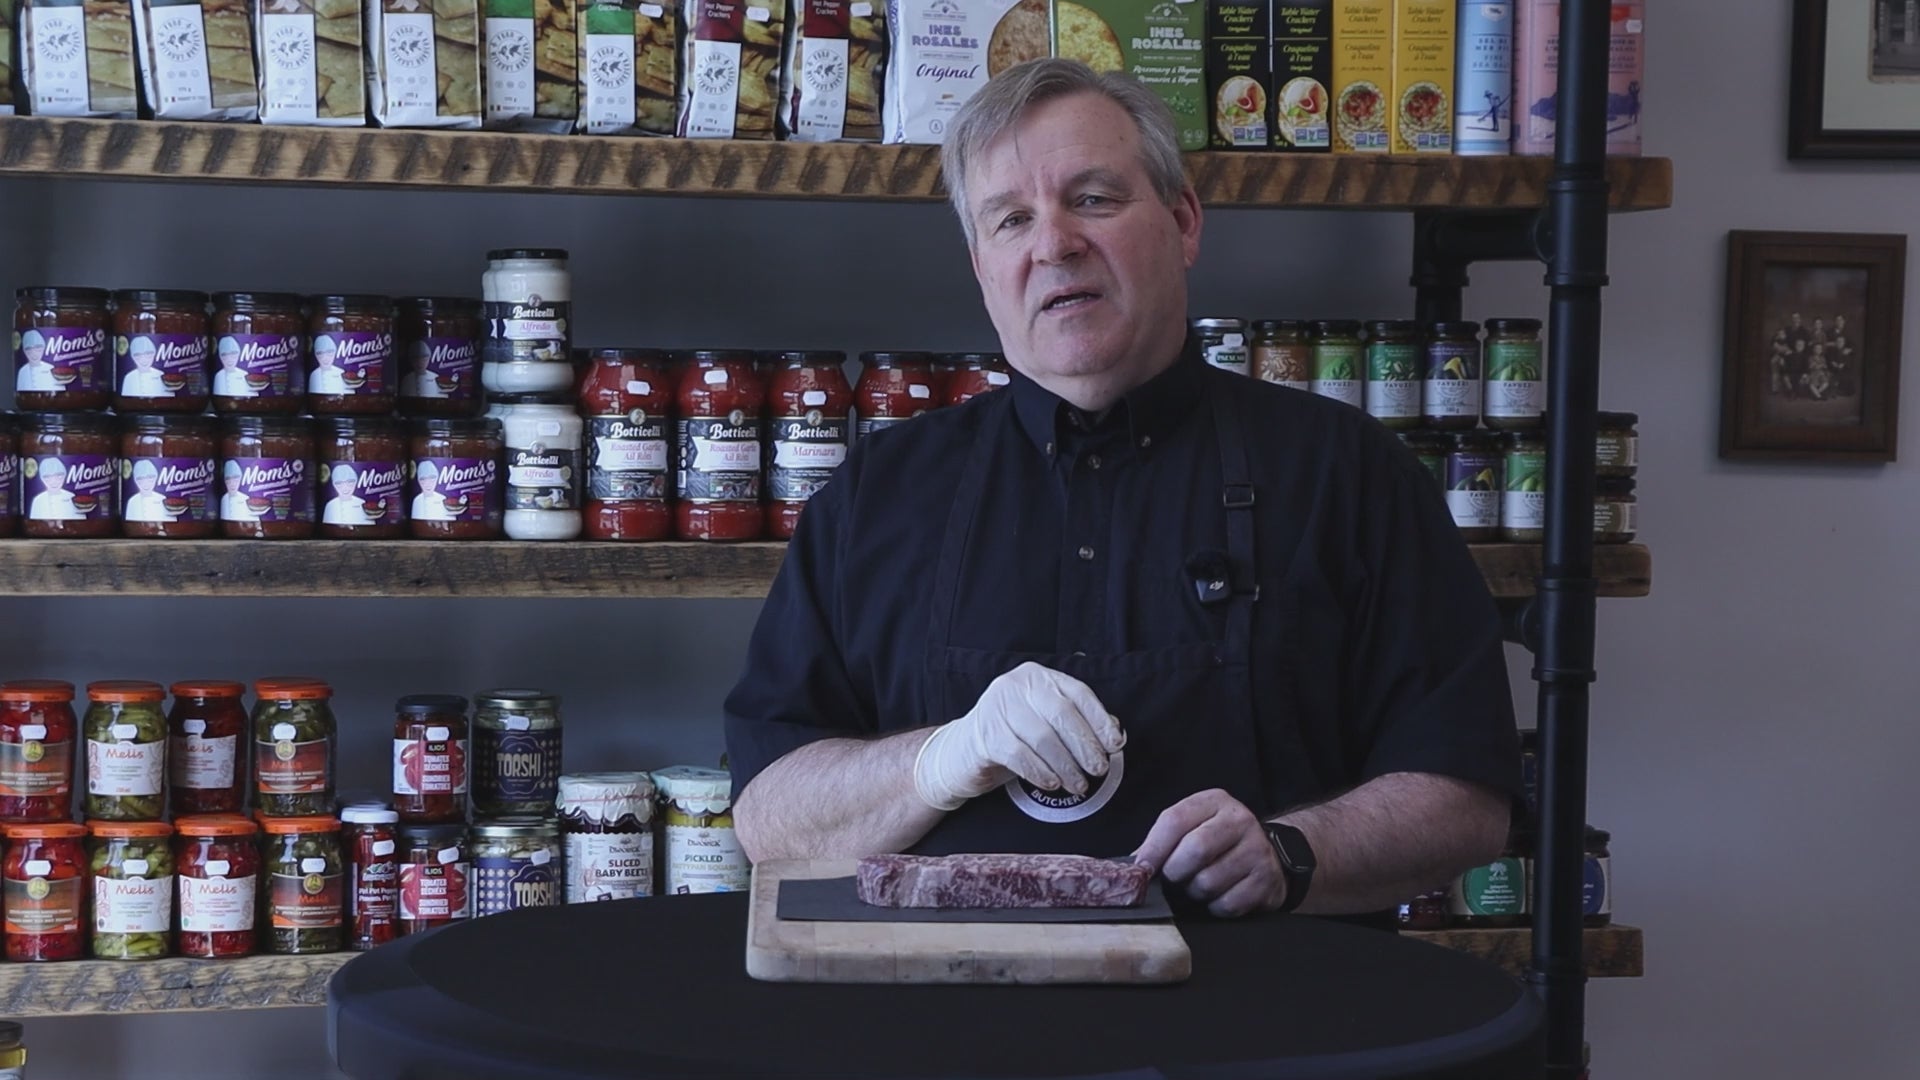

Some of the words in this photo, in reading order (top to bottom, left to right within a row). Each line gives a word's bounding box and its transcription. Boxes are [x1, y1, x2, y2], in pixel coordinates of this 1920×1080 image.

[707, 10, 731, 19] Crackers
[816, 8, 838, 16] Crackers
[1236, 6, 1259, 15] Water
[1300, 7, 1321, 16] Water
[1224, 15, 1254, 23] Crackers
[1286, 16, 1316, 24] Crackers
[929, 24, 962, 36] INES
[1150, 27, 1184, 38] INES
[912, 35, 979, 49] ROSALES
[1132, 38, 1202, 50] ROSALES
[916, 63, 981, 83] Original
[512, 305, 555, 319] Botticelli
[520, 322, 551, 332] Alfredo
[45, 330, 97, 356] Mom's
[337, 334, 385, 359] Mom's
[156, 337, 202, 362] Mom's
[240, 338, 289, 361] Mom's
[431, 339, 475, 363] Mom's
[610, 422, 661, 439] Botticelli
[709, 423, 757, 440] Botticelli
[788, 423, 838, 440] Botticelli
[610, 443, 641, 452] Roasted
[792, 446, 836, 457] Marinara
[517, 452, 559, 466] Botticelli
[66, 458, 113, 484] Mom's
[157, 461, 208, 486] Mom's
[241, 462, 293, 486] Mom's
[357, 465, 402, 489] Mom's
[438, 461, 487, 485] Mom's
[523, 469, 553, 479] Alfredo
[106, 748, 144, 760] Melis
[496, 753, 541, 777] TORSHI
[608, 859, 640, 867] SLICED
[684, 854, 723, 862] PICKLED
[595, 868, 622, 877] BABY
[116, 885, 154, 895] Melis
[199, 883, 237, 894] Melis
